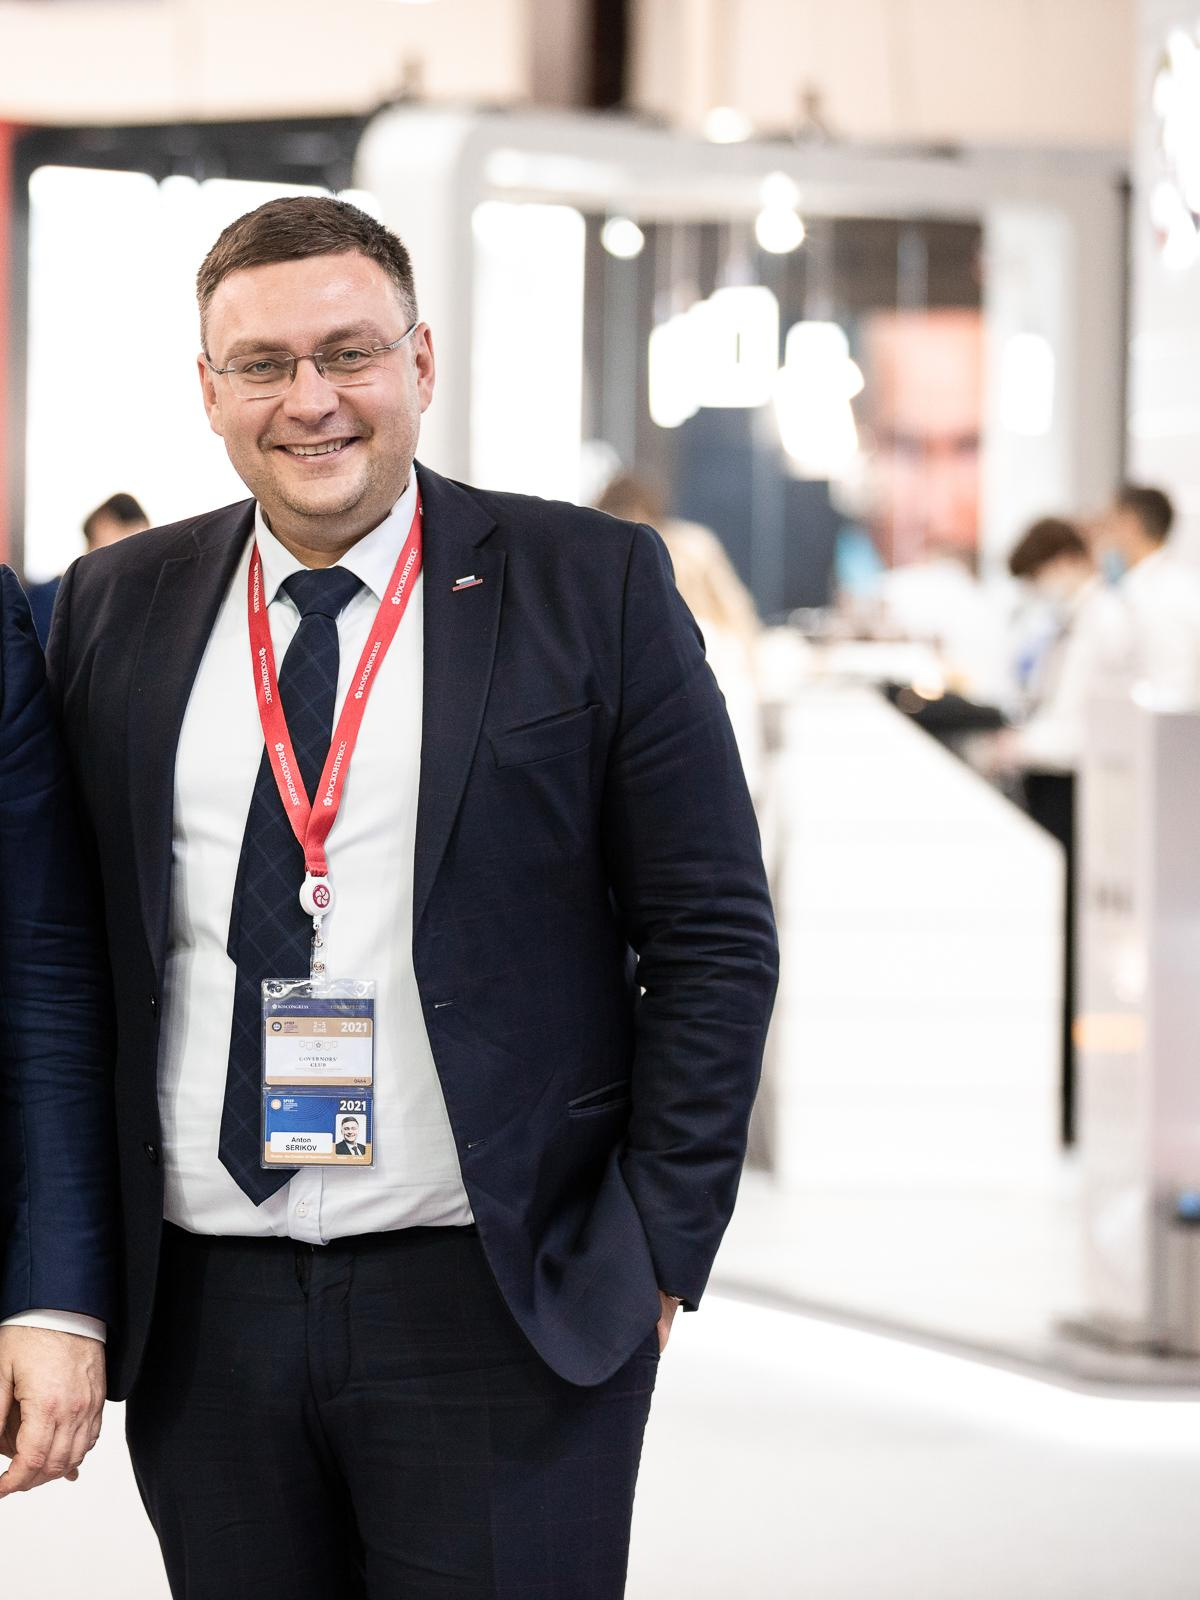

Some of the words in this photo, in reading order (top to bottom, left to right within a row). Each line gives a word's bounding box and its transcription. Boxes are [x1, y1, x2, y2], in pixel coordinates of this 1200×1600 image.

[395, 548, 417, 598] РОСКОНГРЕСС
[260, 655, 272, 704] РОСКОНГРЕСС
[358, 641, 381, 691] ROSCONGRESS
[279, 751, 299, 806] ROSCONGRESS
[326, 741, 347, 797] РОСКОНГРЕСС
[340, 1022, 368, 1033] 2021
[339, 1100, 367, 1111] 2021
